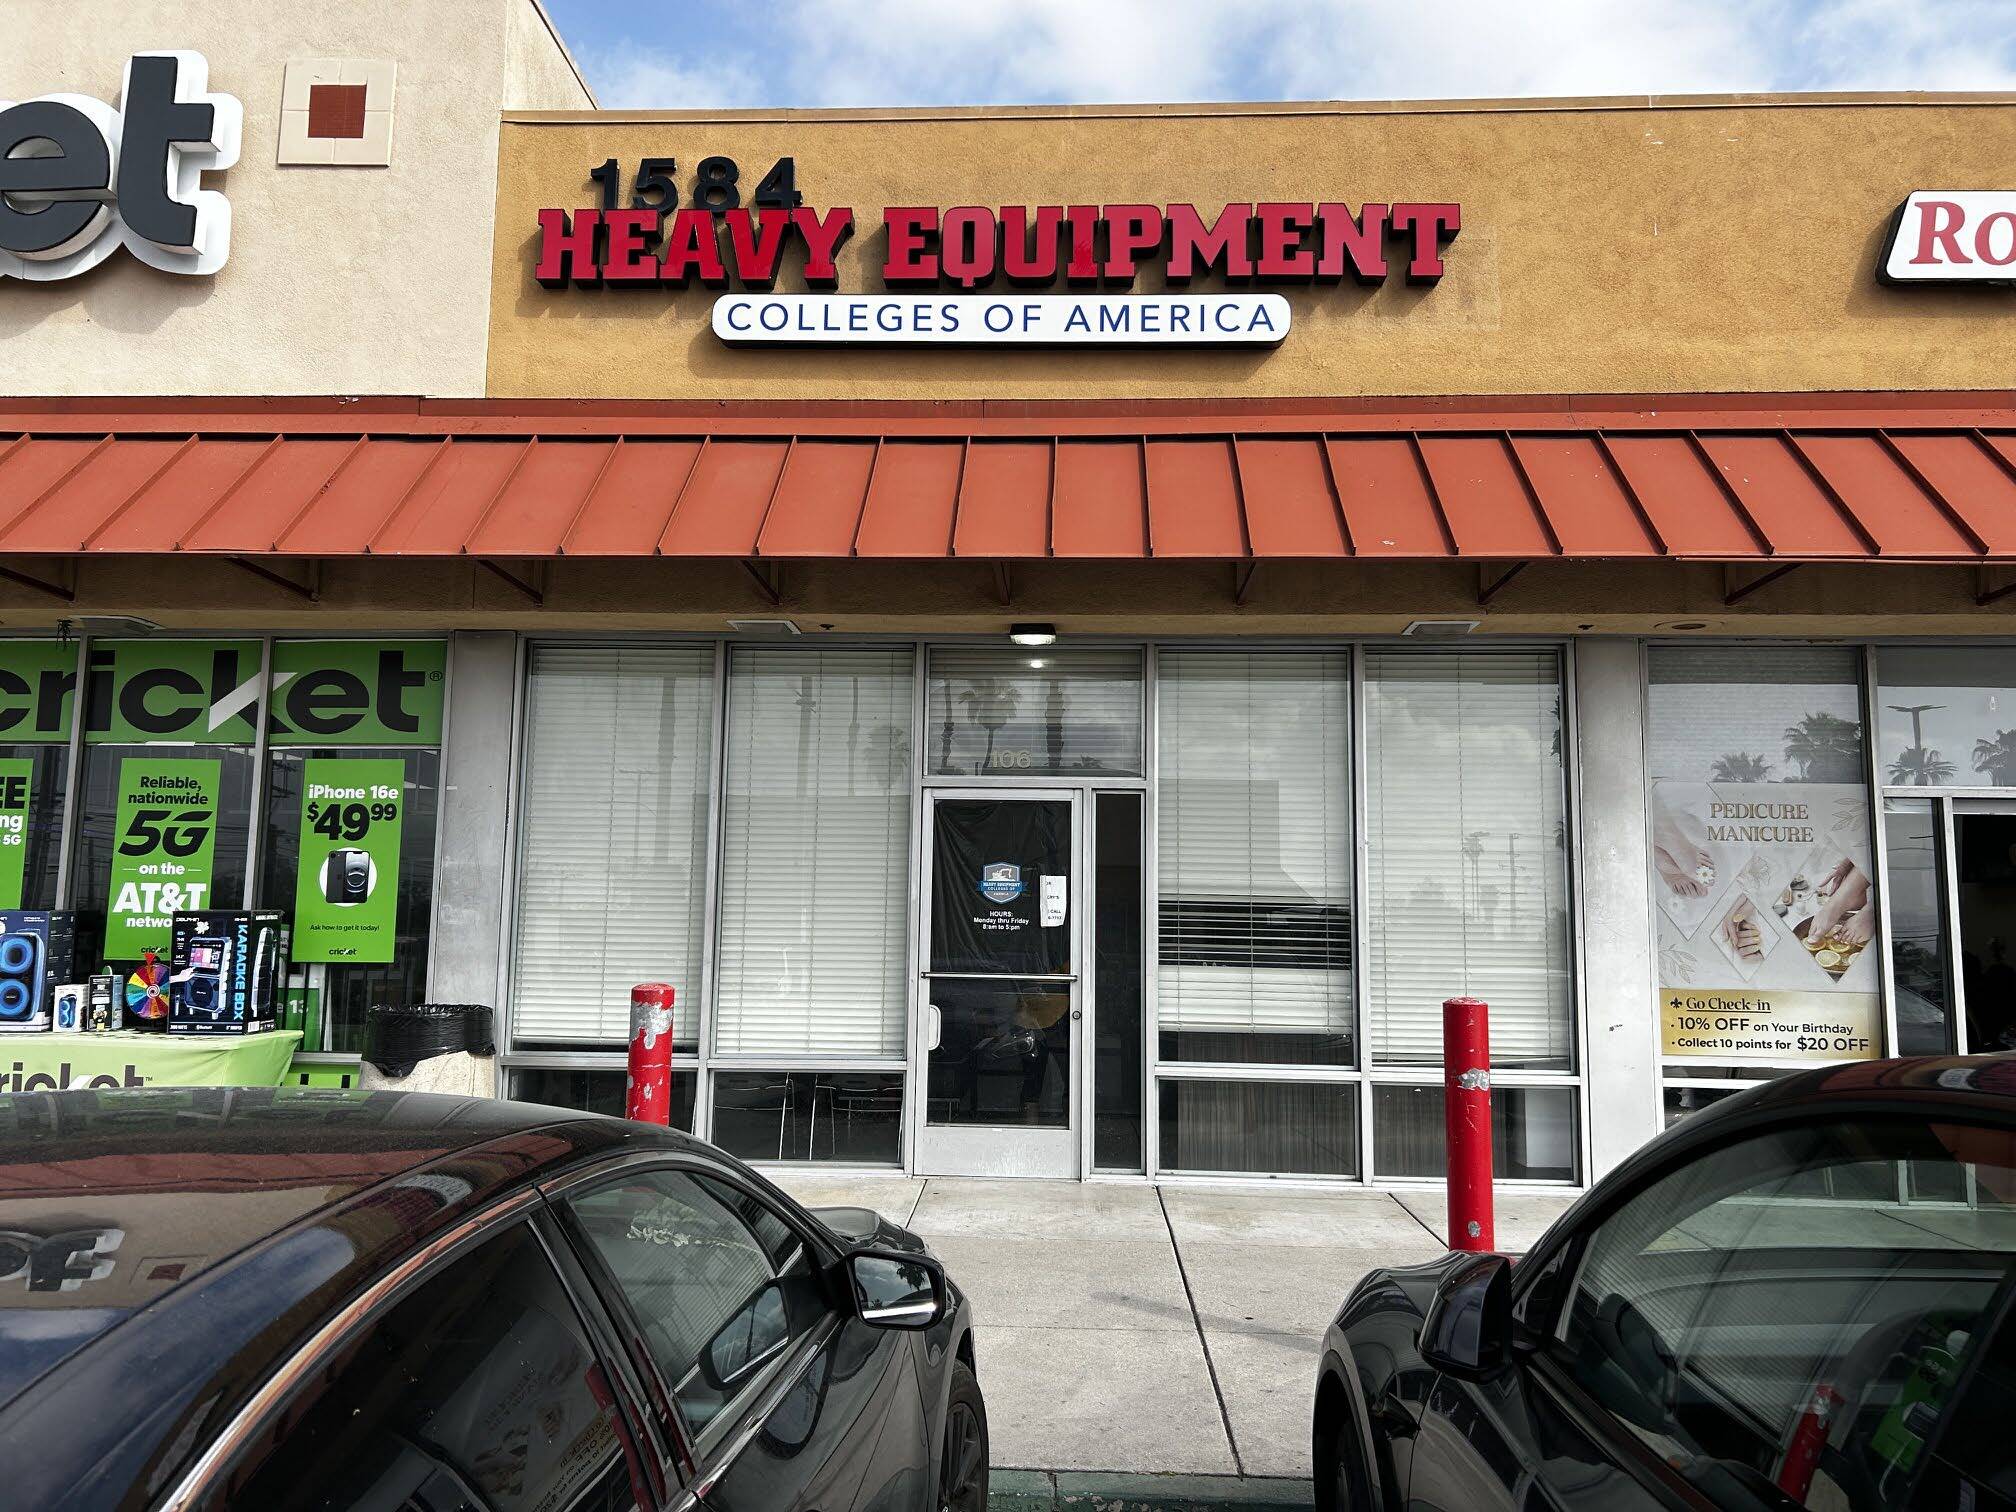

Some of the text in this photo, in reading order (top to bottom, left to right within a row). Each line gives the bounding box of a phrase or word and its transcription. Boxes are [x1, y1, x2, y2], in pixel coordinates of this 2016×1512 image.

[590, 156, 803, 213] 1584
[535, 203, 1461, 290] HEAVY EQUIPMENT
[727, 302, 1275, 332] COLLEGES OF AMERICA
[0, 776, 27, 809] E
[140, 776, 202, 792] Reliable,
[308, 784, 399, 799] iPhone 16e
[128, 792, 209, 805] nationwide
[1710, 802, 1809, 820] PEDICURE
[2, 834, 21, 846] 5G
[118, 810, 213, 857] 5G
[1706, 826, 1814, 843] MANICURE
[139, 862, 186, 875] on the
[112, 882, 207, 915] AT&T
[361, 924, 380, 932] today!
[1011, 917, 1030, 925] Friday
[234, 924, 249, 990] KARAOKE
[233, 992, 246, 1020] BOX
[1686, 997, 1771, 1012] Go Check-in
[1678, 1017, 1854, 1036] 10% OFF on Your Birthday
[1677, 1035, 1869, 1052] Collect 10 points for $20 OFF
